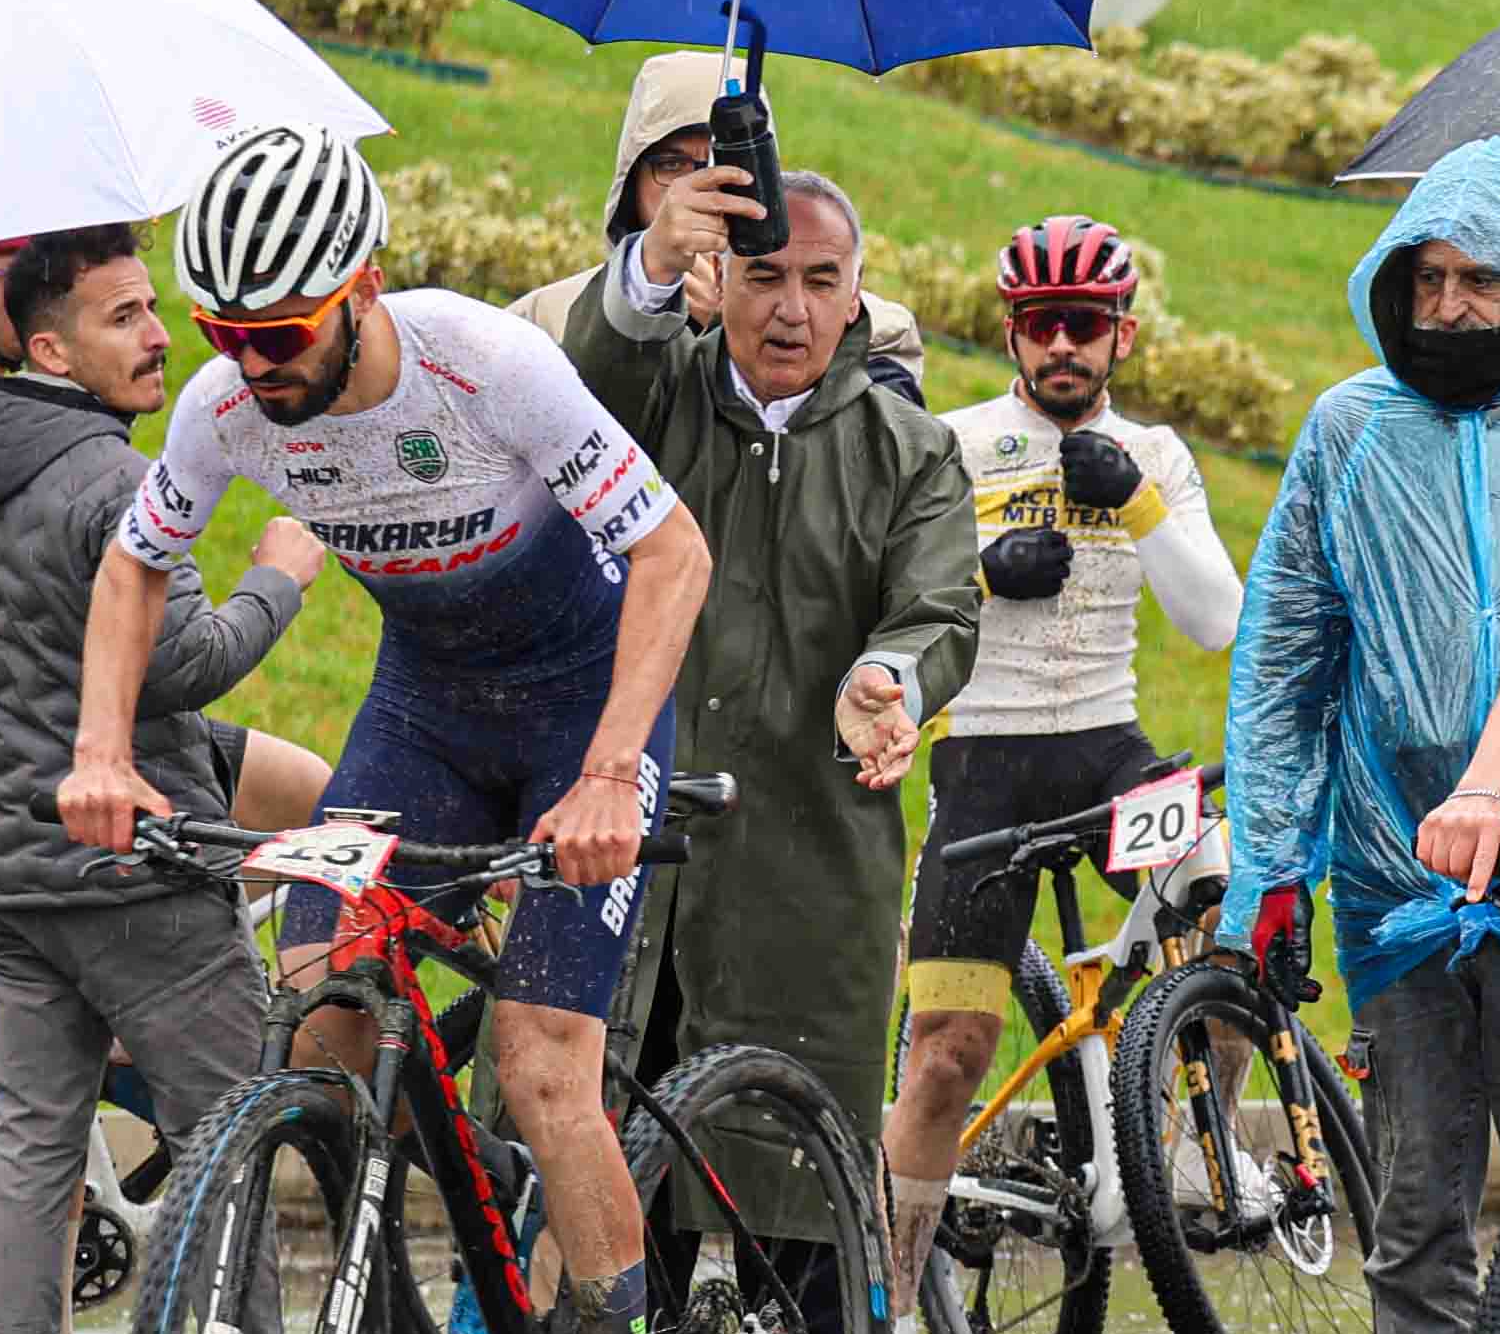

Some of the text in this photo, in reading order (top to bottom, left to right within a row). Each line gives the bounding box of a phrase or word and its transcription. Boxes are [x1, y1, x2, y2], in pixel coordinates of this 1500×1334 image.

[327, 210, 358, 272] LAZER
[570, 446, 637, 518] LCANO
[309, 507, 494, 553] SAKARYA
[1003, 507, 1057, 525] MTB
[338, 522, 521, 575] LCANO
[1126, 802, 1185, 852] 20
